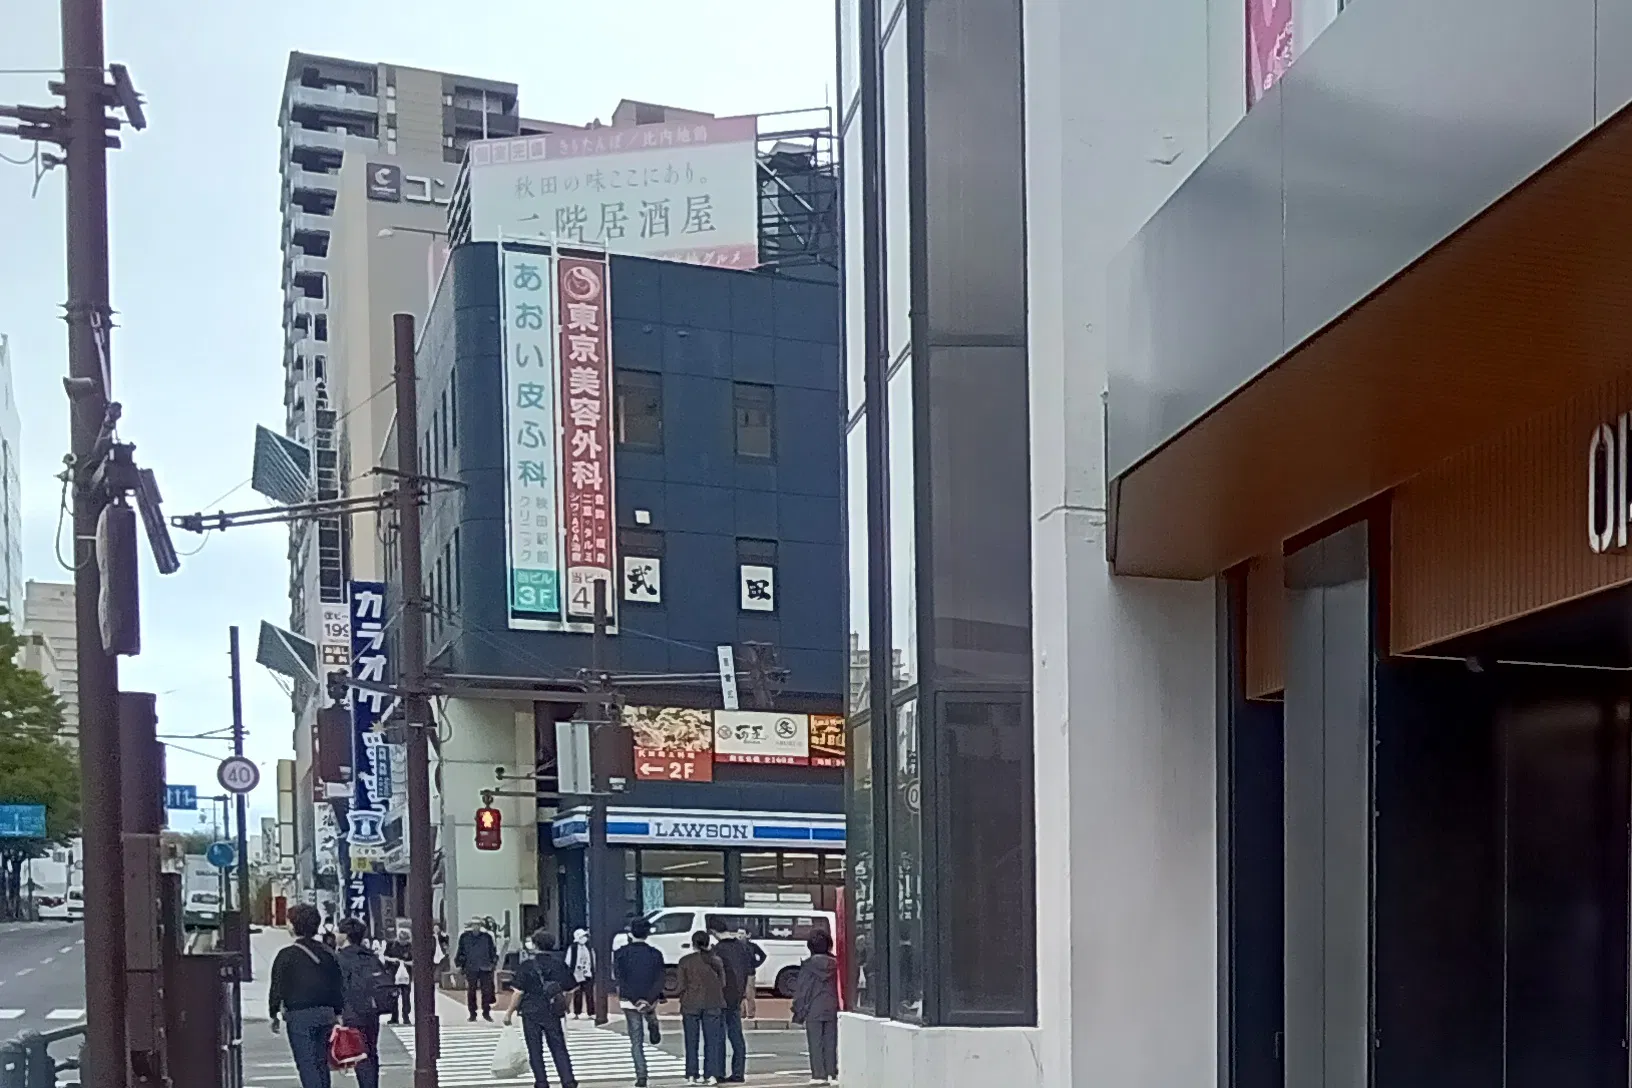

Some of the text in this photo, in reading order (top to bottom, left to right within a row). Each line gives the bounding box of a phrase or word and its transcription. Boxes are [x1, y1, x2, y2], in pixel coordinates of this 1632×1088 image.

[514, 161, 708, 199] 秋田の味ここにあり。
[513, 263, 547, 489] あおい皮ふ科
[566, 302, 603, 490] 東京美容外科
[518, 586, 552, 605] 3F
[227, 766, 251, 784] 40
[669, 761, 695, 780] 2F
[654, 822, 748, 840] LAWSON
